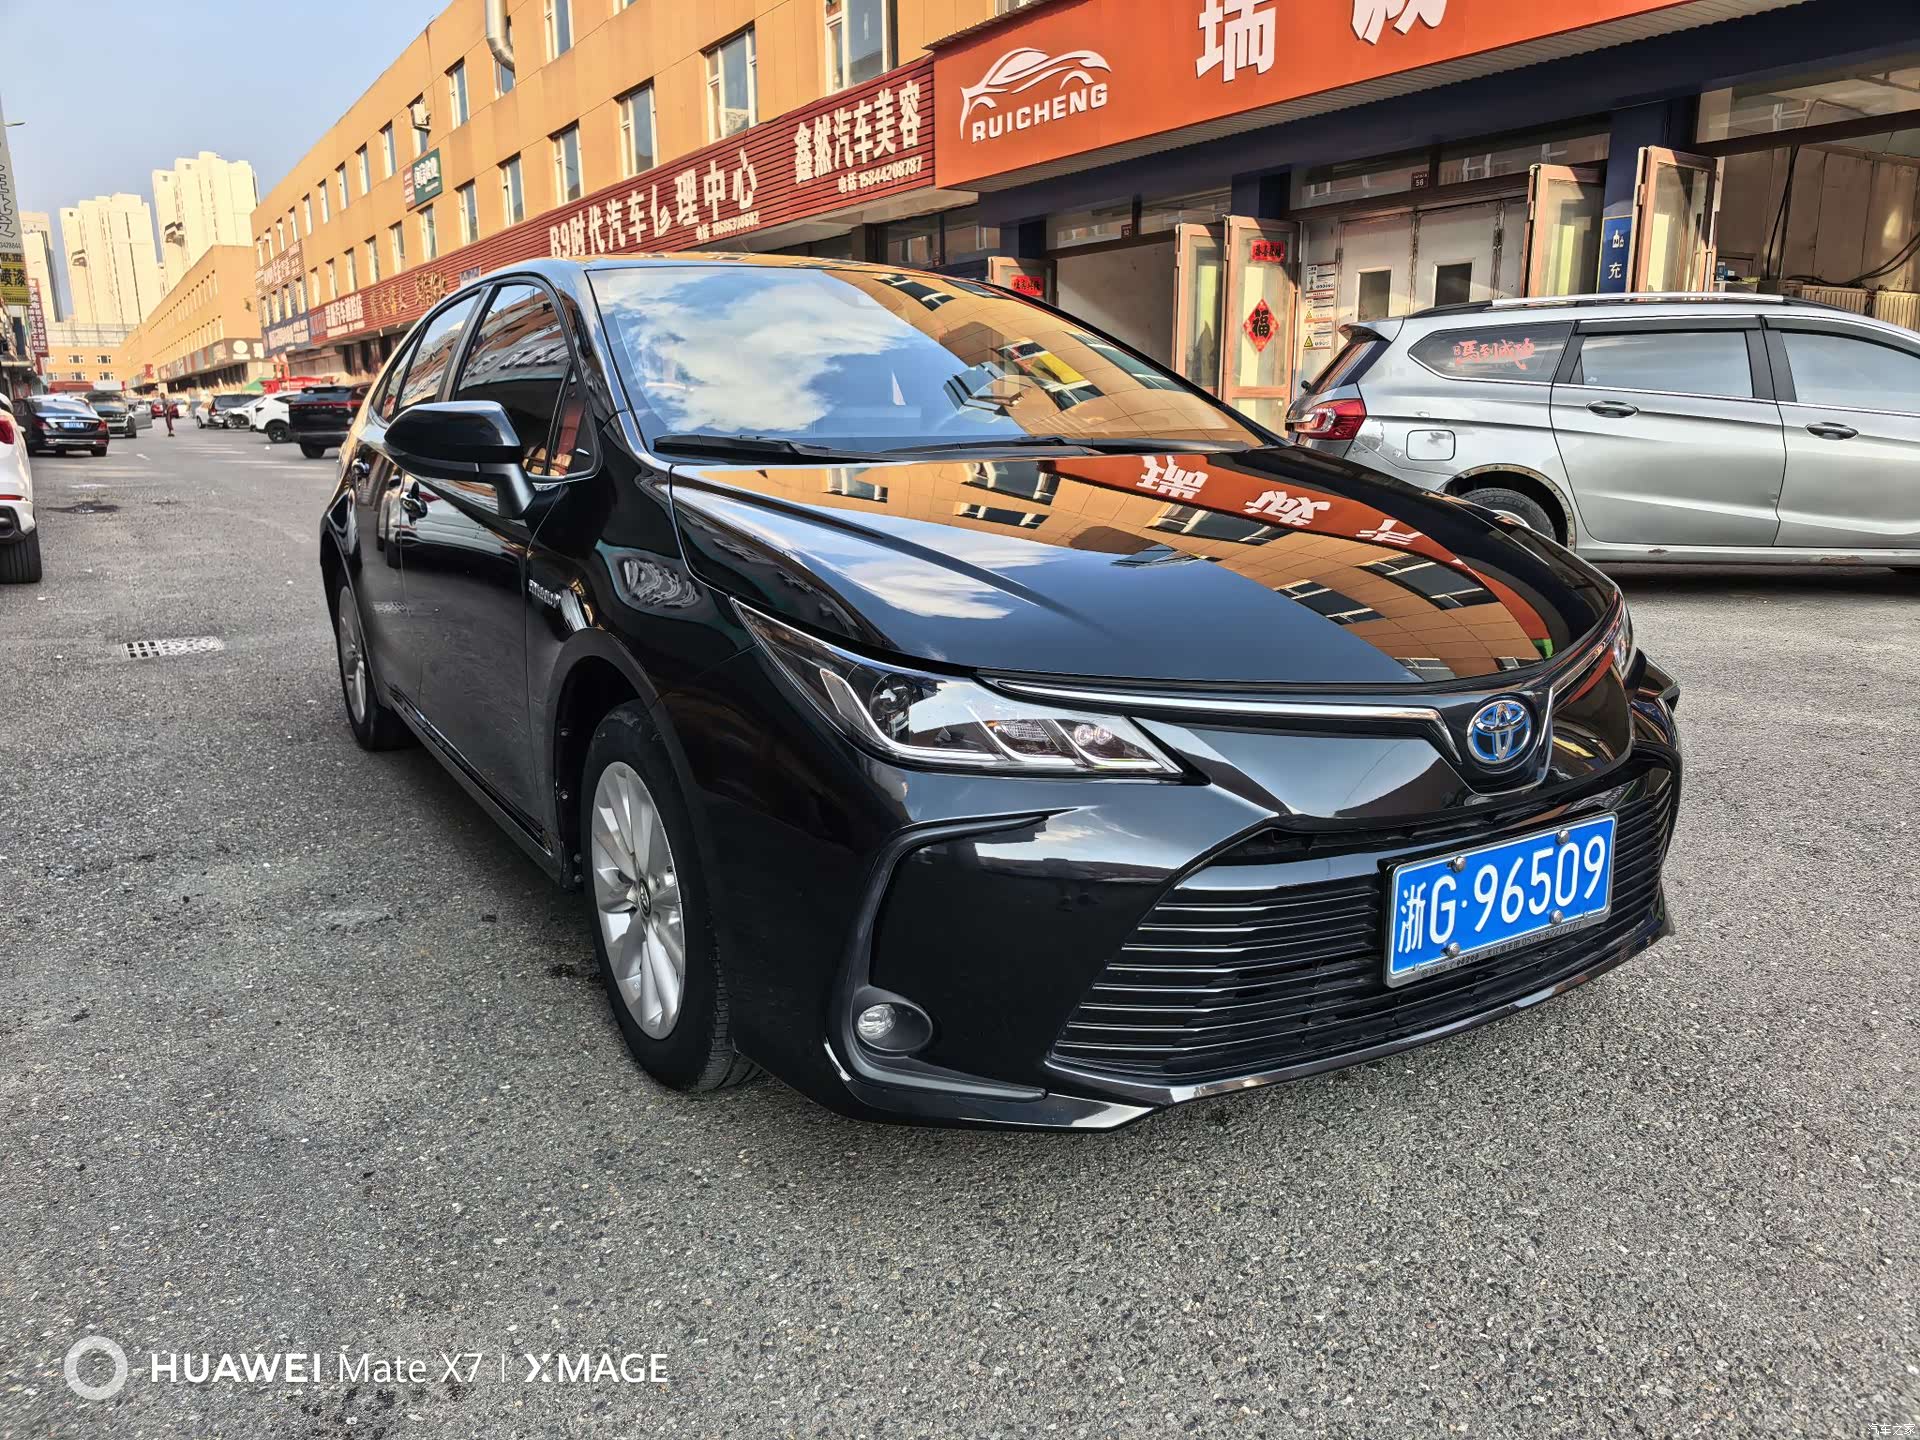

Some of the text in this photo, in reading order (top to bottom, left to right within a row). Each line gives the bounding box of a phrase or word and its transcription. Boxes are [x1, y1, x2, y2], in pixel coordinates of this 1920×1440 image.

[971, 82, 1109, 144] RUICHENG
[794, 80, 922, 184] 鑫然汽车美容
[859, 155, 922, 188] 15844208787
[1608, 261, 1622, 280] 充
[1251, 308, 1270, 338] 福
